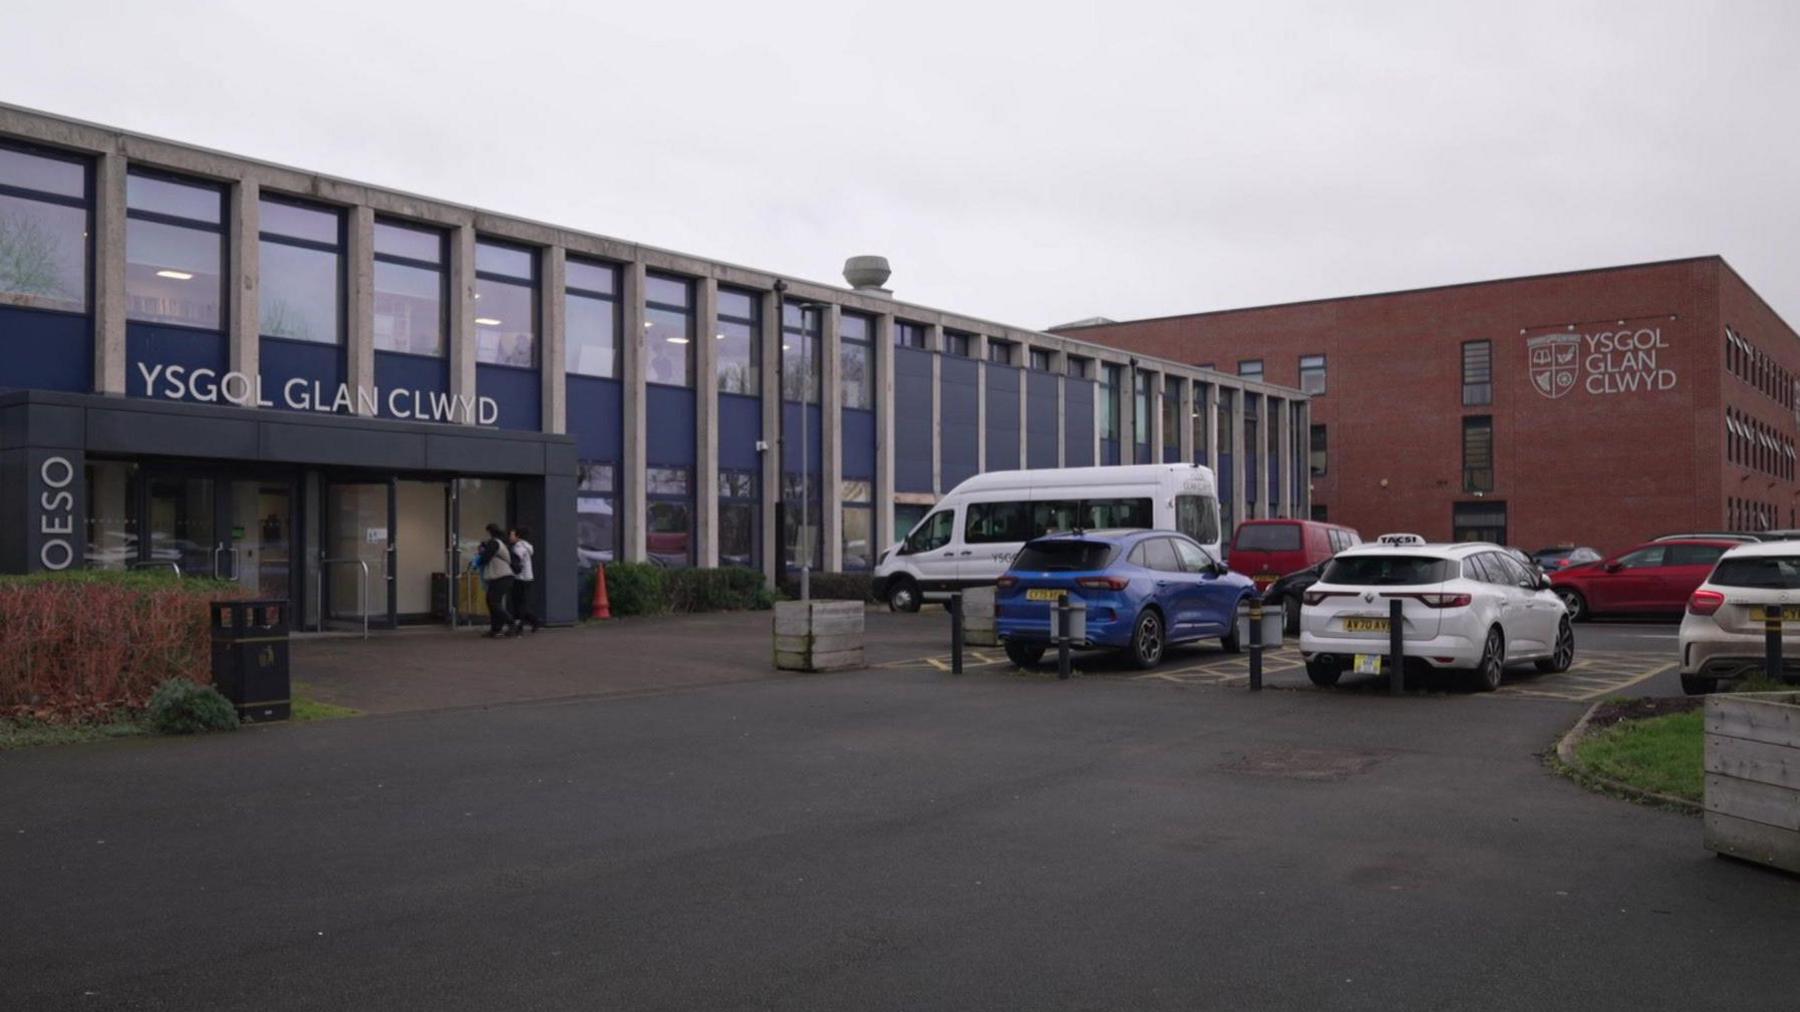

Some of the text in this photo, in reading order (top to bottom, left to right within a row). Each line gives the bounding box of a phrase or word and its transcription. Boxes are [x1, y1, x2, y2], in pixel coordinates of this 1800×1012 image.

[1585, 328, 1669, 353] YSGOL
[1585, 349, 1656, 373] GLAN
[137, 362, 498, 425] YSGOL GLAN CLWYD
[1585, 369, 1676, 394] CLWYD
[41, 456, 73, 570] OESO
[1381, 535, 1417, 544] TACSI
